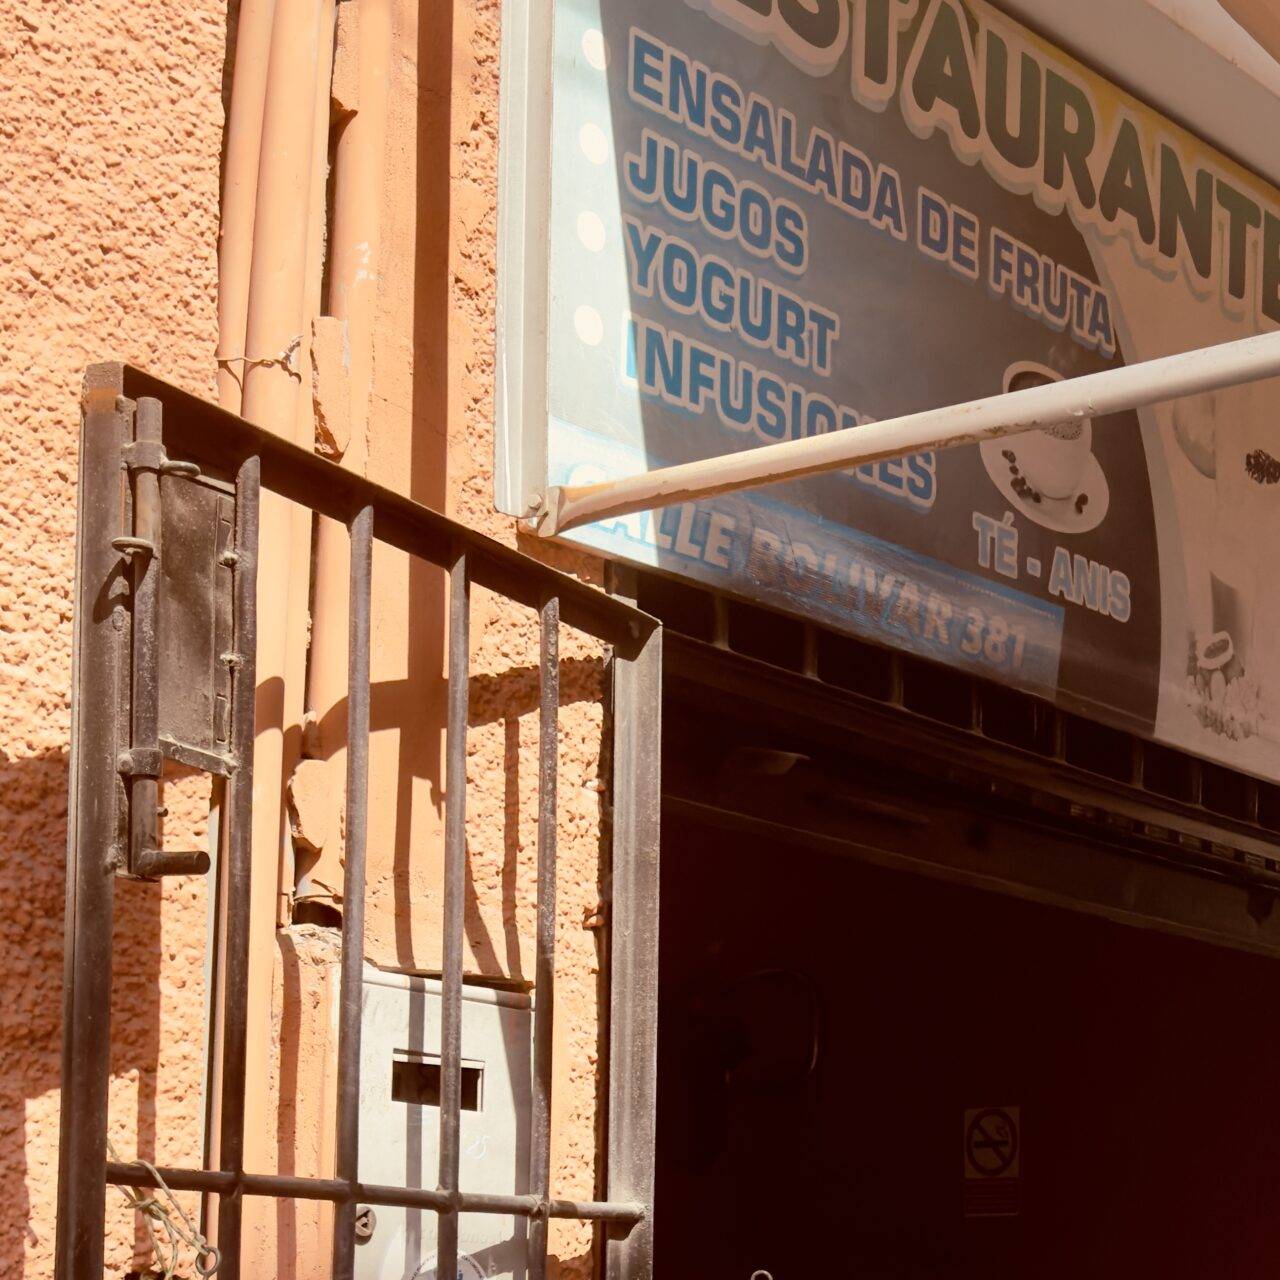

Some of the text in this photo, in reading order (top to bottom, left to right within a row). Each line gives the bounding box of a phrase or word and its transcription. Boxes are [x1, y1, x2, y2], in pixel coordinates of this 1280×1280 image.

[627, 132, 805, 268] JUGOS
[629, 30, 1116, 352] ENSALADA DE FRUTA
[626, 222, 837, 374] YOGURT
[972, 504, 1018, 578] TÉ
[1049, 548, 1131, 623] ANIS
